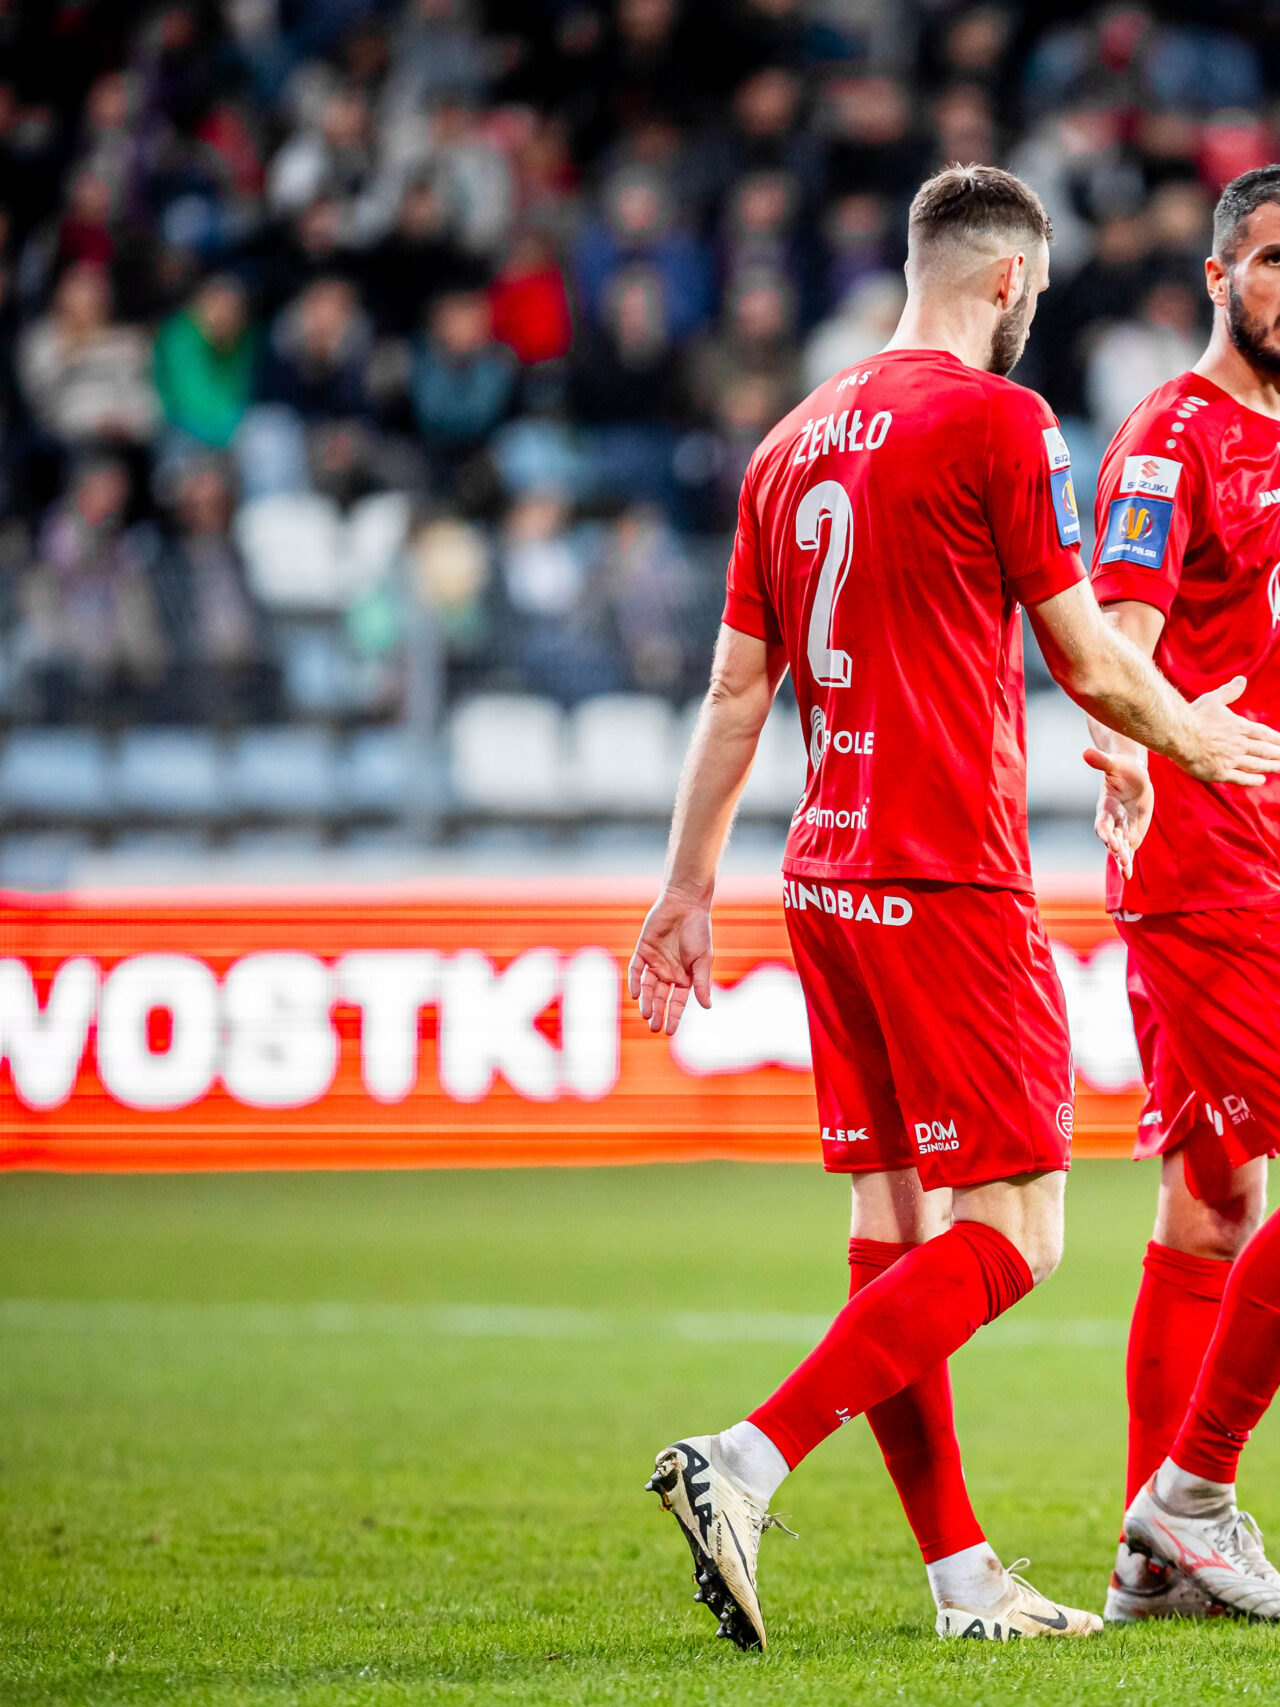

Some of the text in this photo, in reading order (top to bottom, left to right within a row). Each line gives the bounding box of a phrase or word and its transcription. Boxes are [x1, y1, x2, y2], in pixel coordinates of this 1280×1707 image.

[792, 409, 893, 466] ŻEMŁO
[795, 479, 855, 689] 2
[783, 872, 913, 927] SINDBAD
[914, 1119, 958, 1144] DOM
